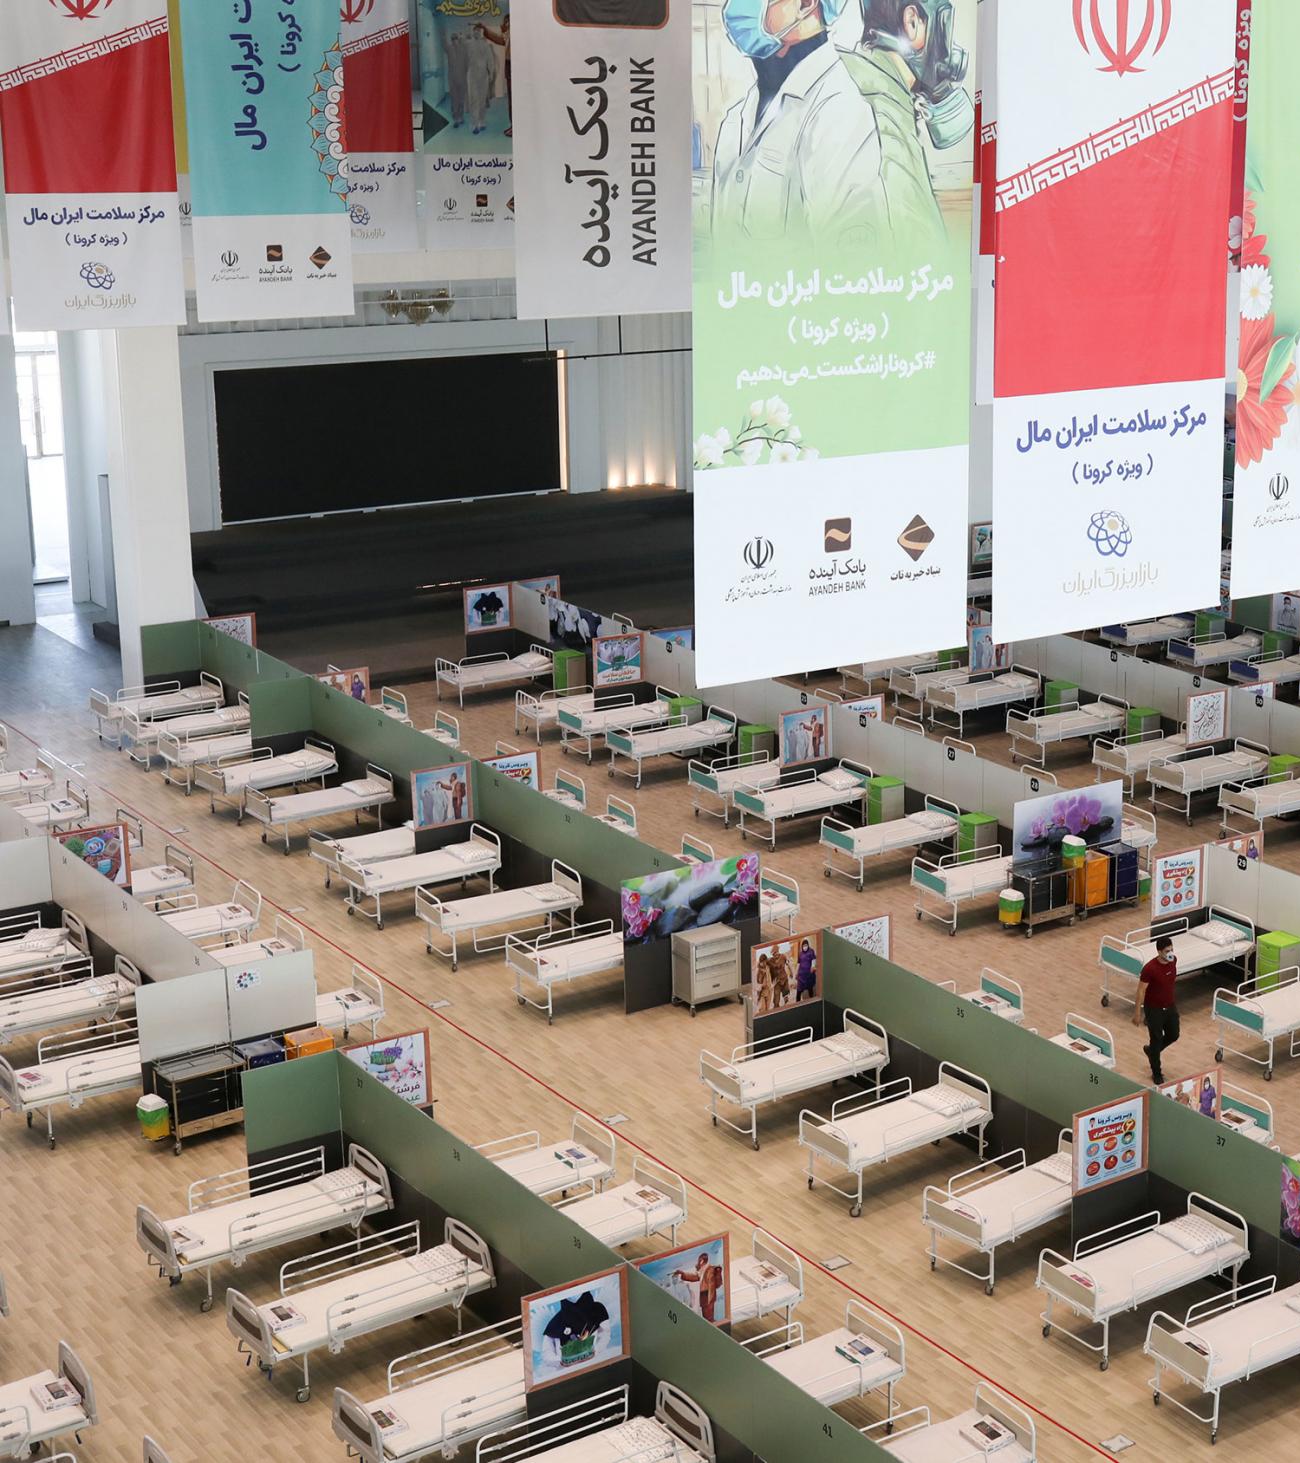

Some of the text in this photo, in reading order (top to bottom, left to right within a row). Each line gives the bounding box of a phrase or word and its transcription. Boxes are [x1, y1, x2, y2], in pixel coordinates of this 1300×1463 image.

[277, 11, 303, 56] کرونا
[229, 34, 264, 95] ایران
[234, 105, 267, 150] مال
[351, 162, 406, 175] مرکز سلامت
[433, 158, 507, 171] سلامت ایران مال
[564, 56, 620, 267] بانک آینده
[629, 57, 657, 267] AYANDEH BANK
[23, 207, 49, 225] مال
[51, 207, 83, 225] ایران
[86, 206, 136, 220] سلامت
[138, 206, 165, 223] مرکز
[718, 264, 954, 309] مرکز سلامت ایران مال
[1016, 404, 1207, 453] مرکز سلامت ایران مال
[808, 558, 867, 581] بانک آینده
[808, 580, 866, 597] AYANDEH BANK
[948, 749, 954, 759] 27
[1031, 780, 1038, 790] 28
[1239, 857, 1246, 869] 29
[957, 1007, 964, 1018] 35
[1089, 1074, 1099, 1085] 36
[1097, 1112, 1133, 1124] ویروس کرونا
[1216, 1135, 1226, 1147] 37
[668, 1310, 677, 1324] 40
[822, 1424, 832, 1438] 41
